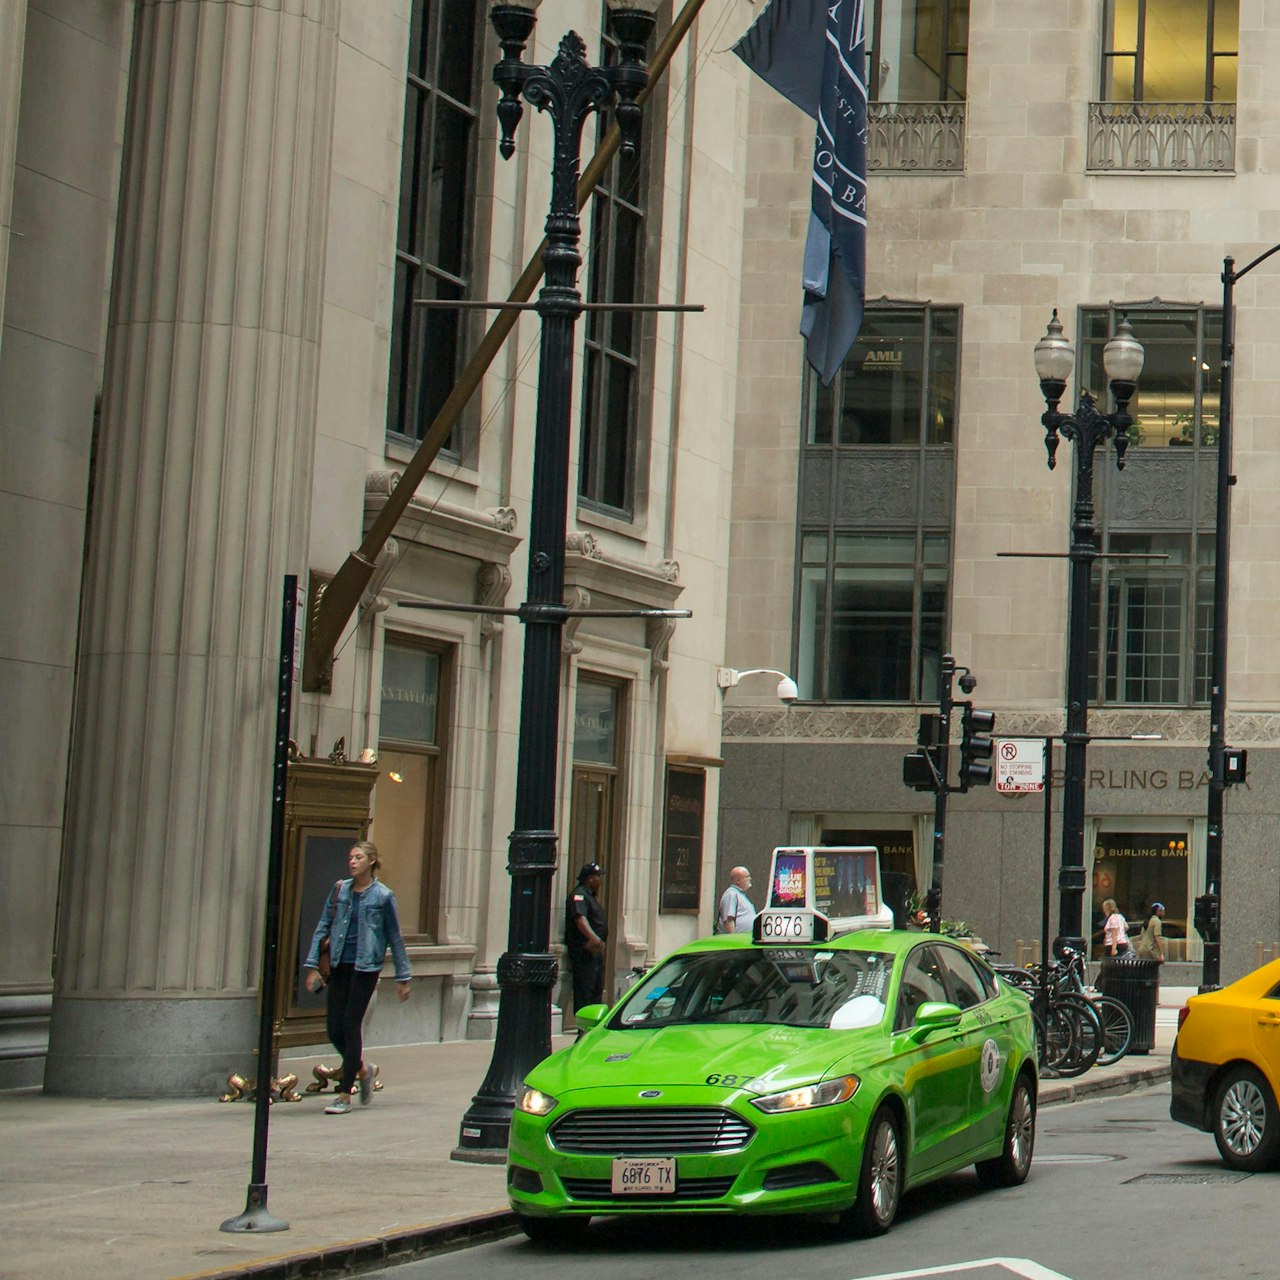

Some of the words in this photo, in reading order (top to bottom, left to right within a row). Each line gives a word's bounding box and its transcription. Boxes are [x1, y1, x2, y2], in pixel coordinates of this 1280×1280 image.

[866, 351, 902, 361] AMLI
[1051, 770, 1169, 790] BRLING
[884, 846, 913, 854] BANK
[1109, 849, 1157, 857] BURLING
[1161, 849, 1191, 857] BANK
[779, 873, 802, 881] BLUE
[779, 880, 802, 888] MAN
[764, 915, 803, 937] 6876
[705, 1073, 767, 1093] 6876
[622, 1167, 651, 1184] 6876
[658, 1167, 672, 1184] TX
